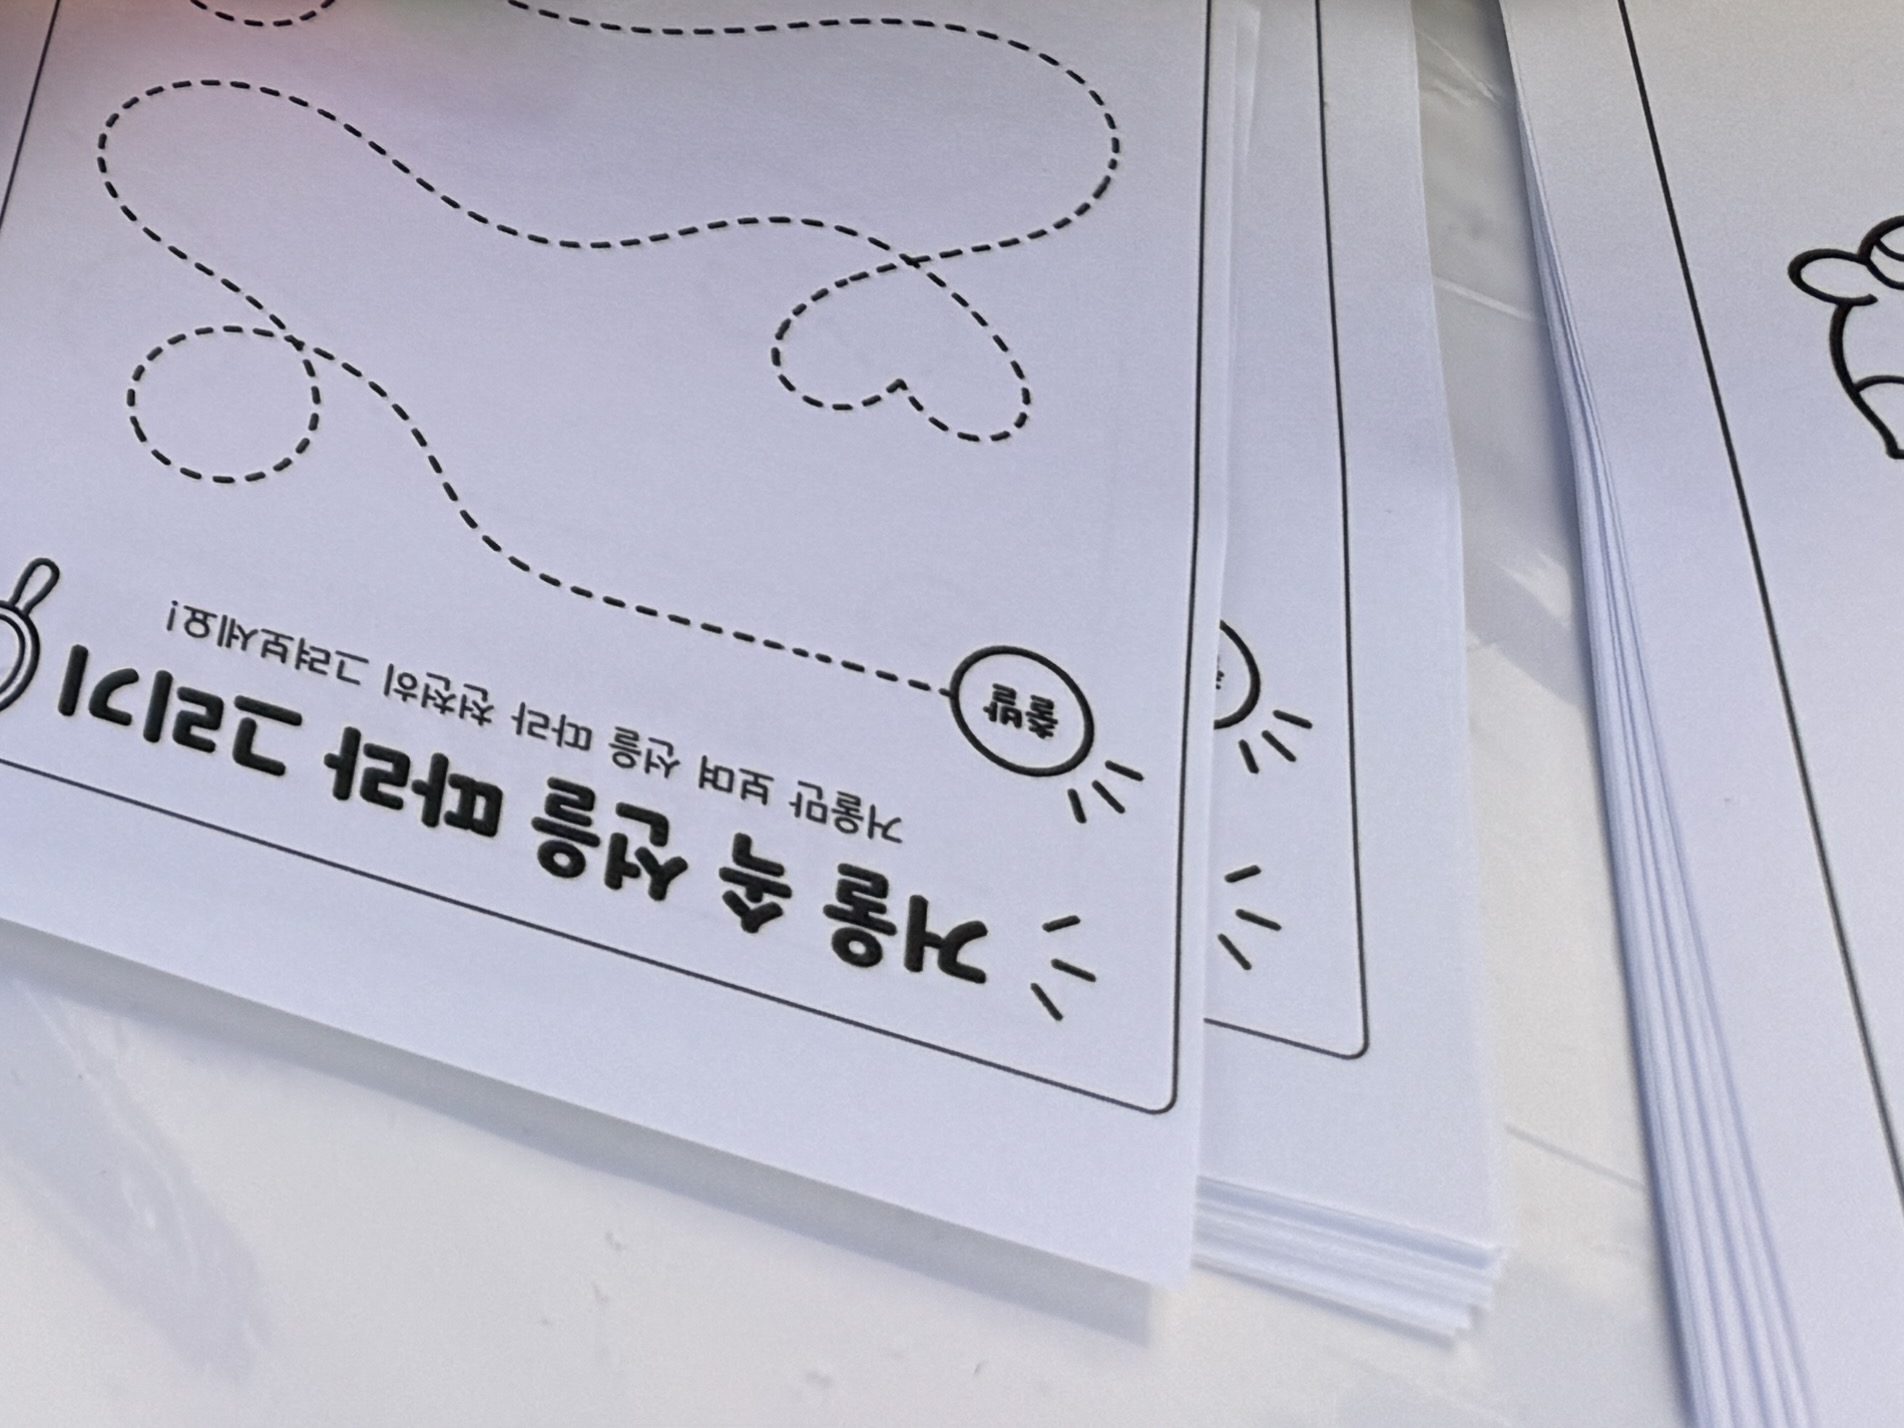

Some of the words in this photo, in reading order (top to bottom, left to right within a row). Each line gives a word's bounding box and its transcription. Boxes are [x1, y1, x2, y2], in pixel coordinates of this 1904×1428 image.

[166, 601, 370, 685] 그려보세요!
[58, 644, 303, 778] 그리기
[383, 663, 495, 727] 천천히
[511, 702, 593, 752] 따라
[982, 684, 1060, 739] 출발
[324, 726, 504, 839] 따라
[608, 726, 681, 779] 선을
[698, 755, 774, 806] 보며
[531, 777, 689, 902] 선을
[789, 780, 903, 844] 거울만
[719, 832, 793, 934] 속
[823, 863, 988, 985] 거울
